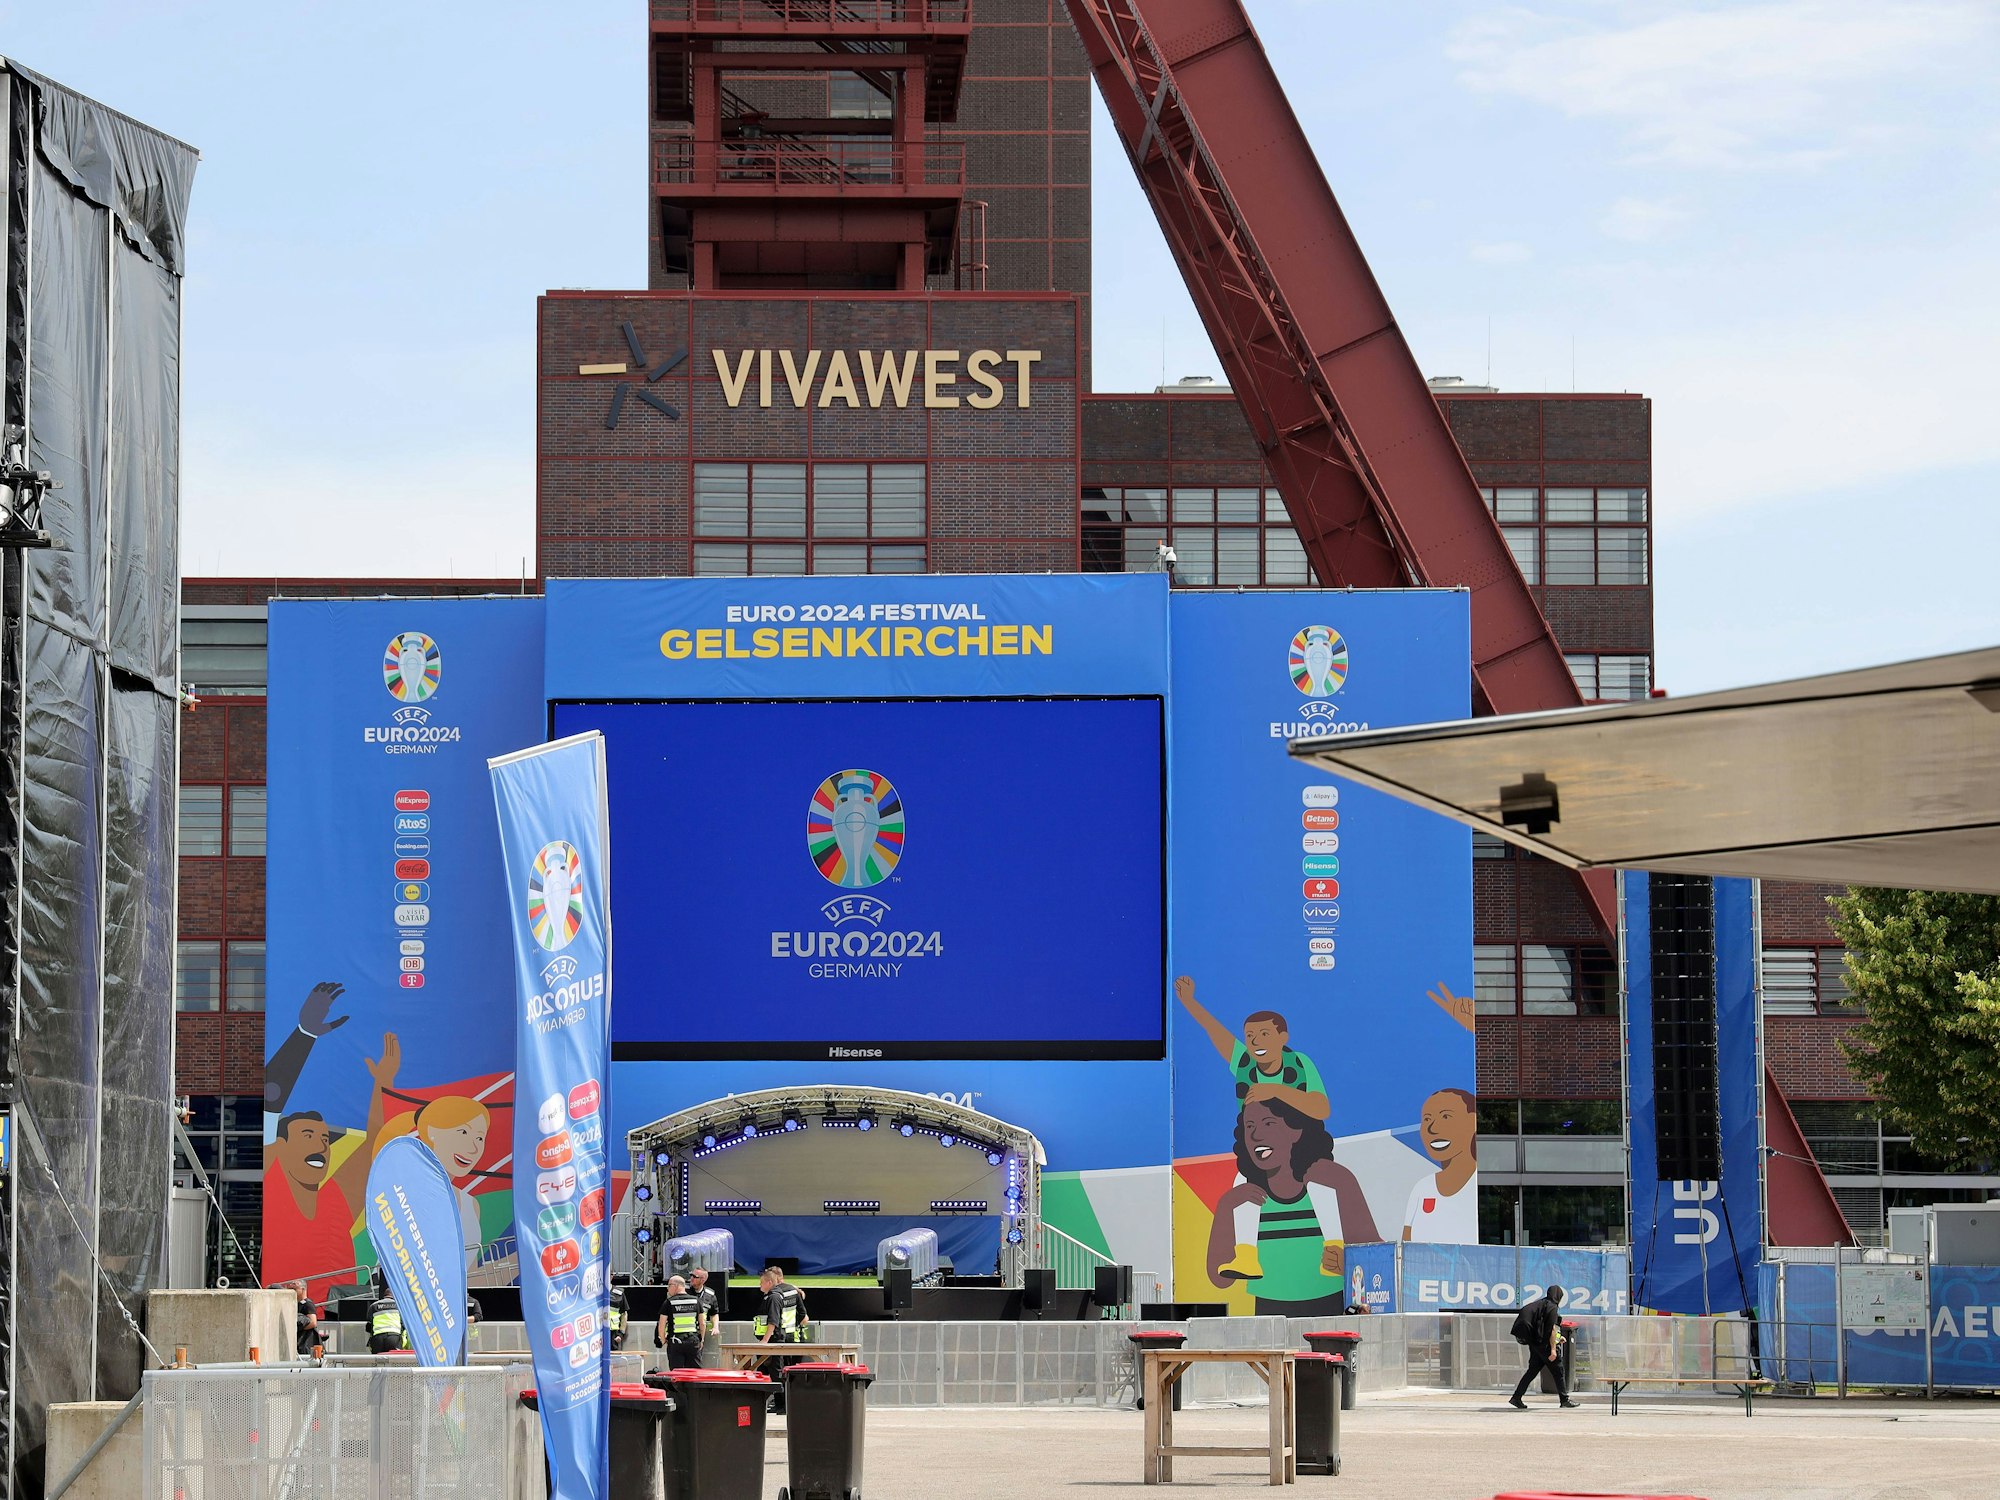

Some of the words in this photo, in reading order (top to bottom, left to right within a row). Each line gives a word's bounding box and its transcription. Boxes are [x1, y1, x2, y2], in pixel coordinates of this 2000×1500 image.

[712, 349, 1042, 409] VIVAWEST
[727, 605, 796, 623] EURO
[801, 604, 865, 622] 2024
[871, 603, 986, 621] FESTIVAL
[659, 625, 1053, 660] GELSENKIRCHEN
[394, 709, 428, 723] UEFA
[1301, 704, 1336, 718] UEFA
[364, 727, 461, 742] EURO2024
[385, 745, 438, 754] GERMANY
[398, 914, 426, 922] QATAR
[824, 900, 885, 922] UEFA
[1304, 906, 1338, 916] vivo
[771, 931, 944, 957] EURO2024
[405, 960, 418, 968] DB
[808, 963, 903, 978] GERMANY
[828, 1047, 882, 1057] Hisense
[1418, 1279, 1518, 1306] EURO
